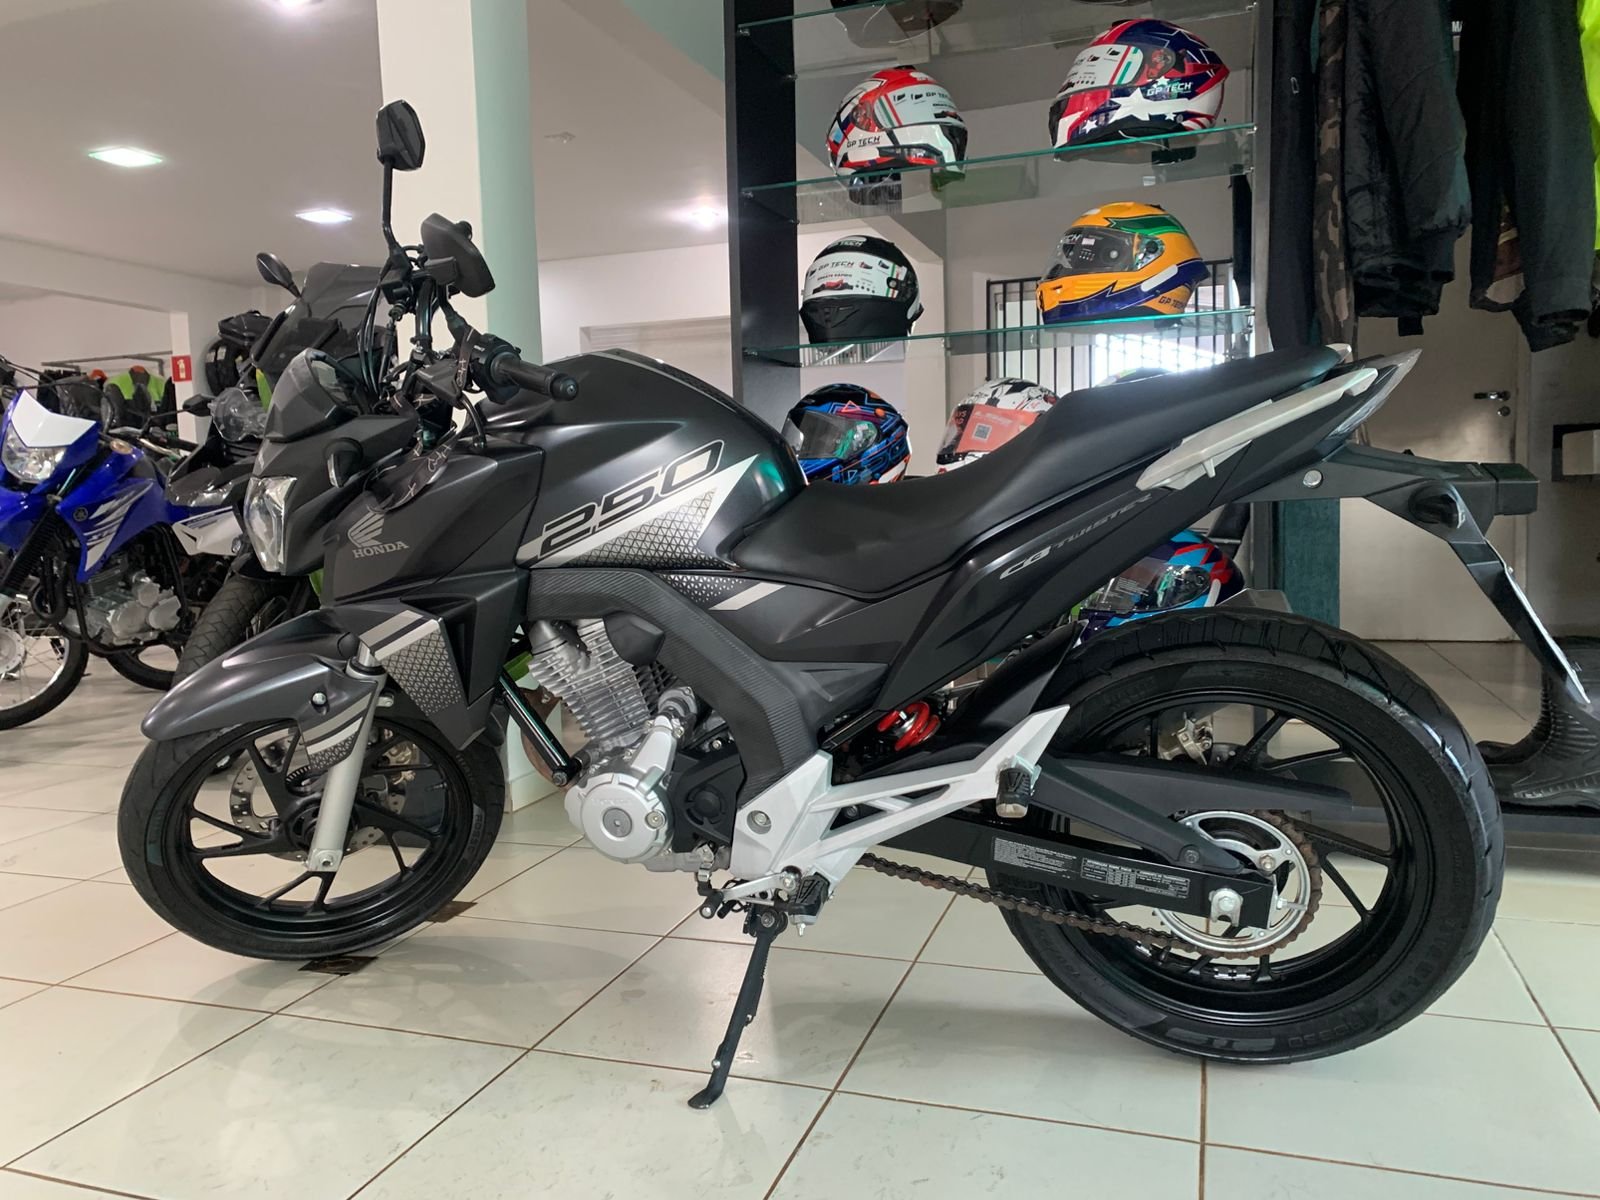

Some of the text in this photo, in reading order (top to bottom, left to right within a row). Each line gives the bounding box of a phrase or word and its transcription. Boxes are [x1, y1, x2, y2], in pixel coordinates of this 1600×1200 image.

[1146, 81, 1192, 97] GP TECH
[846, 135, 881, 149] GP TECH
[830, 260, 855, 268] TECH
[1158, 295, 1172, 304] GP
[539, 439, 725, 558] 250
[351, 541, 409, 559] HONDA
[999, 546, 1053, 580] CB
